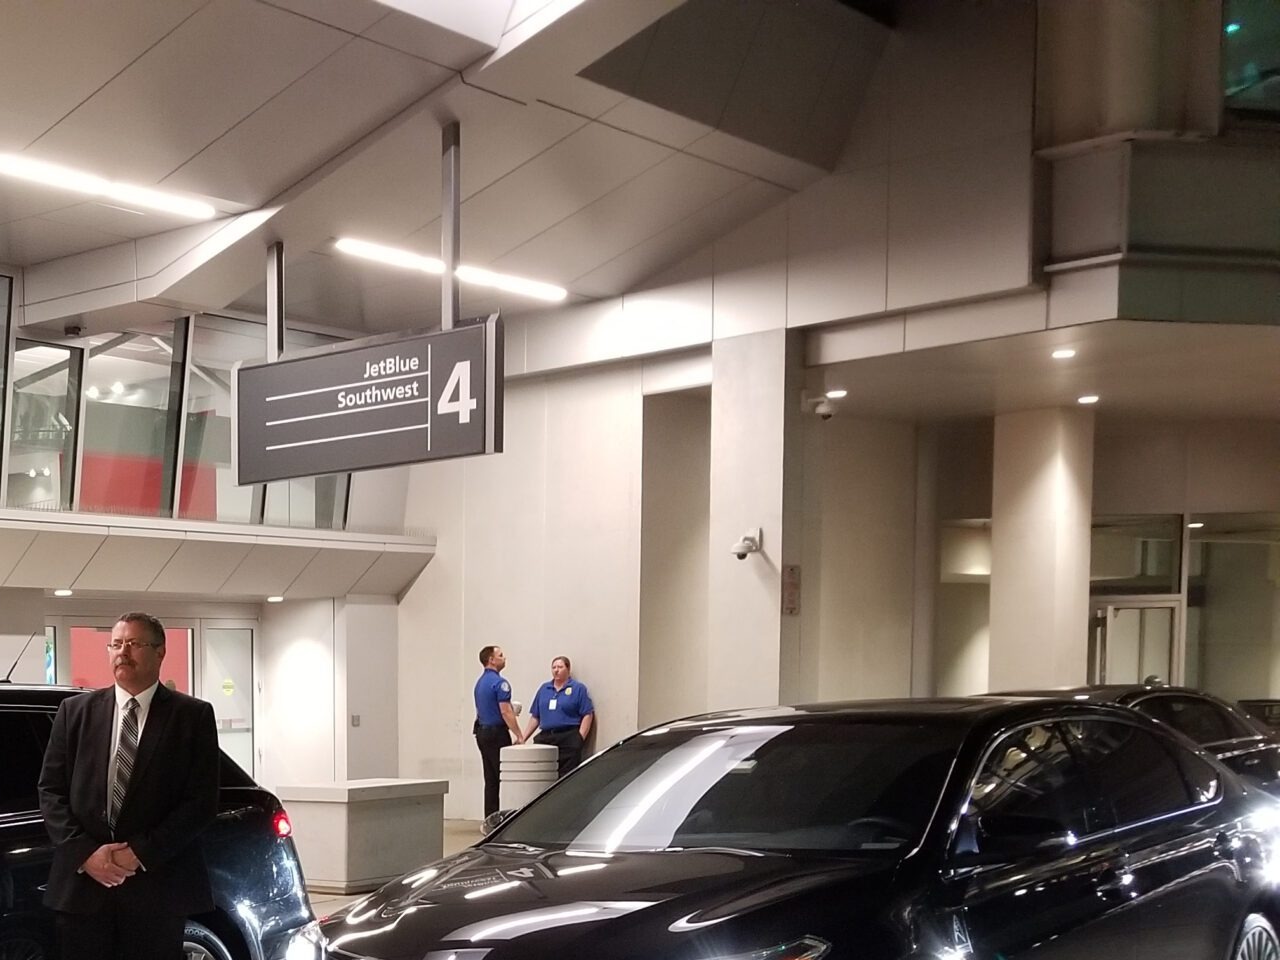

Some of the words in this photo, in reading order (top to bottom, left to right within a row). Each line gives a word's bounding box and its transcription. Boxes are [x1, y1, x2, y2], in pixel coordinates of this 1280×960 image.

[363, 355, 419, 379] JetBlue
[337, 381, 419, 408] Southwest
[436, 360, 477, 424] 4
